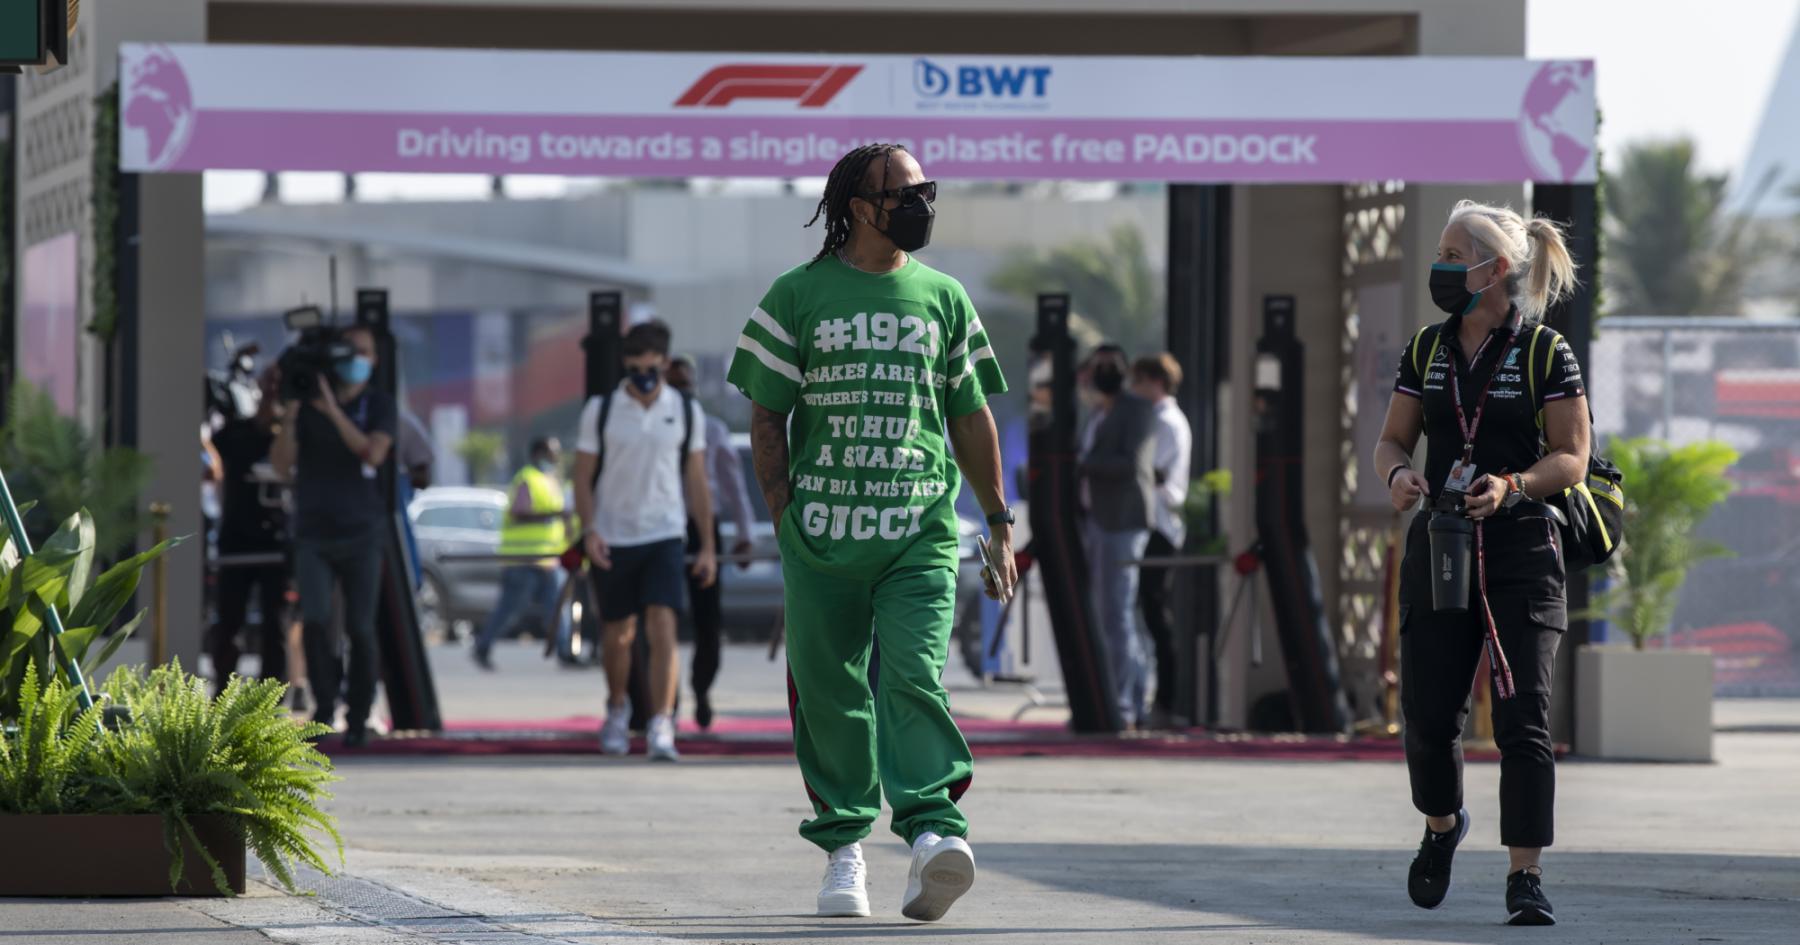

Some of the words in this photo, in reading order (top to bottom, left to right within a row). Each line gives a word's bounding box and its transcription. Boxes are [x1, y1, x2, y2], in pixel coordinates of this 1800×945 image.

[957, 65, 1052, 97] BWT
[397, 128, 531, 163] Driving
[539, 131, 694, 161] towards
[703, 135, 722, 161] a
[922, 132, 1043, 166] plastic
[1052, 132, 1125, 163] free
[1133, 133, 1318, 164] PADDOCK
[813, 312, 940, 358] #1921
[871, 363, 915, 382] ARE
[873, 391, 905, 405] THE
[827, 415, 857, 438] TO
[861, 415, 921, 441] HUG
[815, 444, 834, 467] A
[802, 501, 924, 540] GUCCI
